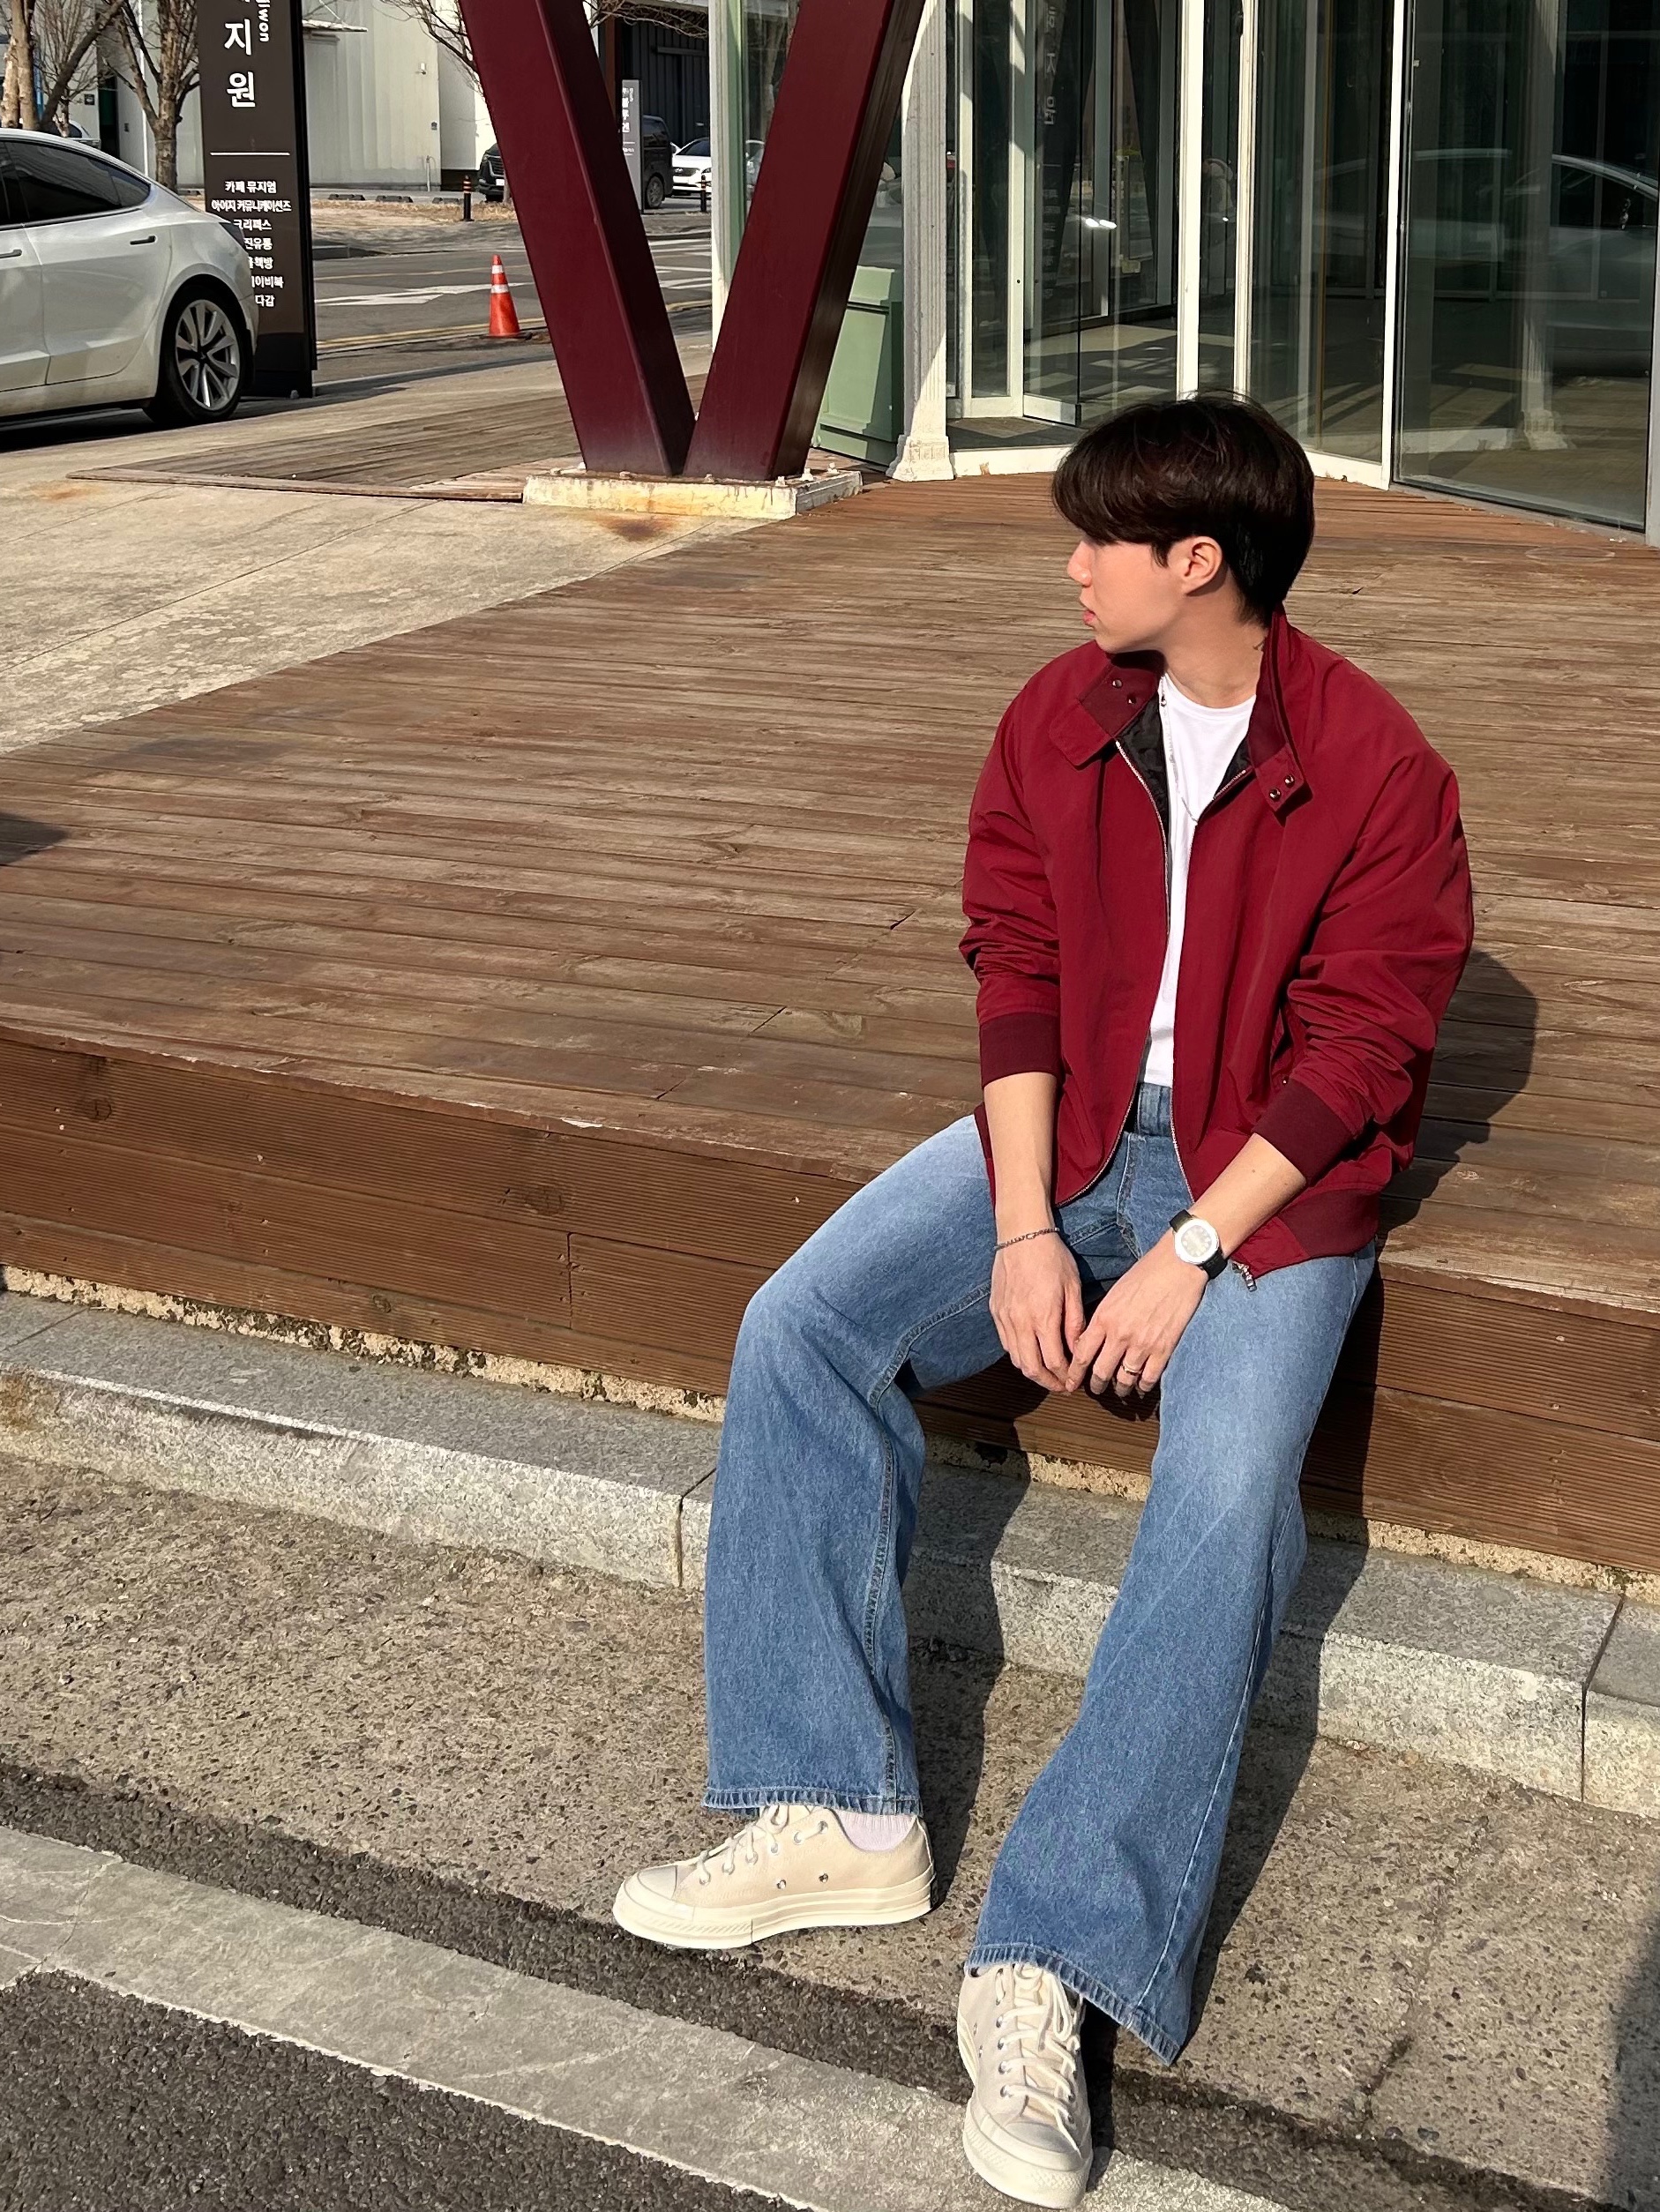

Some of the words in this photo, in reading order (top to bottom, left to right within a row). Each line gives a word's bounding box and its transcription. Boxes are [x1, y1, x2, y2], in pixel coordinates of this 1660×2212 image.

[224, 0, 256, 108] 지원
[225, 181, 245, 194] 카페
[246, 181, 277, 194] 뮤지엄
[211, 199, 236, 213] 아이지
[236, 199, 292, 213] 커뮤니케이션즈
[255, 294, 275, 307] 다감
